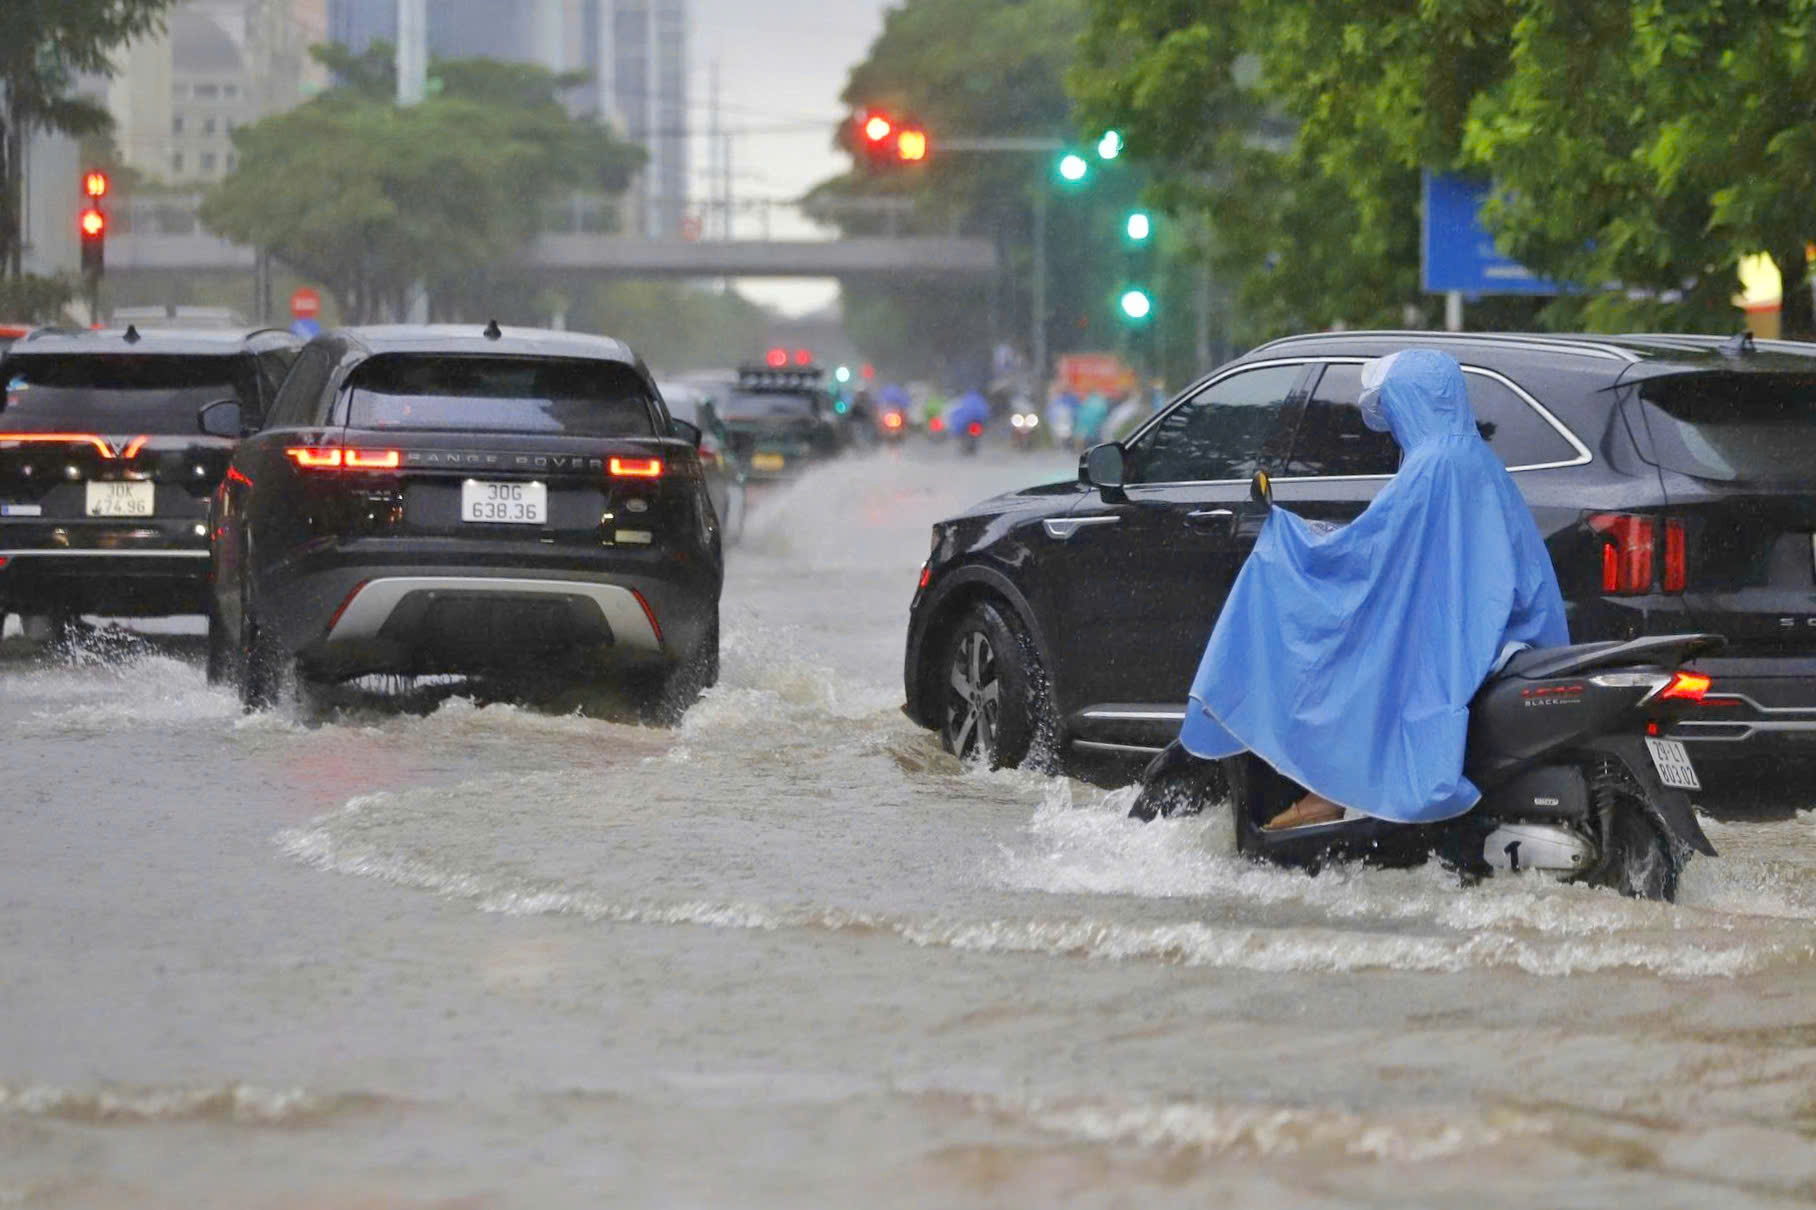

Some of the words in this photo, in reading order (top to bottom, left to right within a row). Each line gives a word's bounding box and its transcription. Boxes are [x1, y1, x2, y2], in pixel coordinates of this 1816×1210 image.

[408, 453, 497, 464] RANGE
[515, 456, 603, 469] ROVER
[487, 484, 522, 501] 30G
[472, 502, 537, 520] 638.36
[1659, 763, 1698, 786] 803.02
